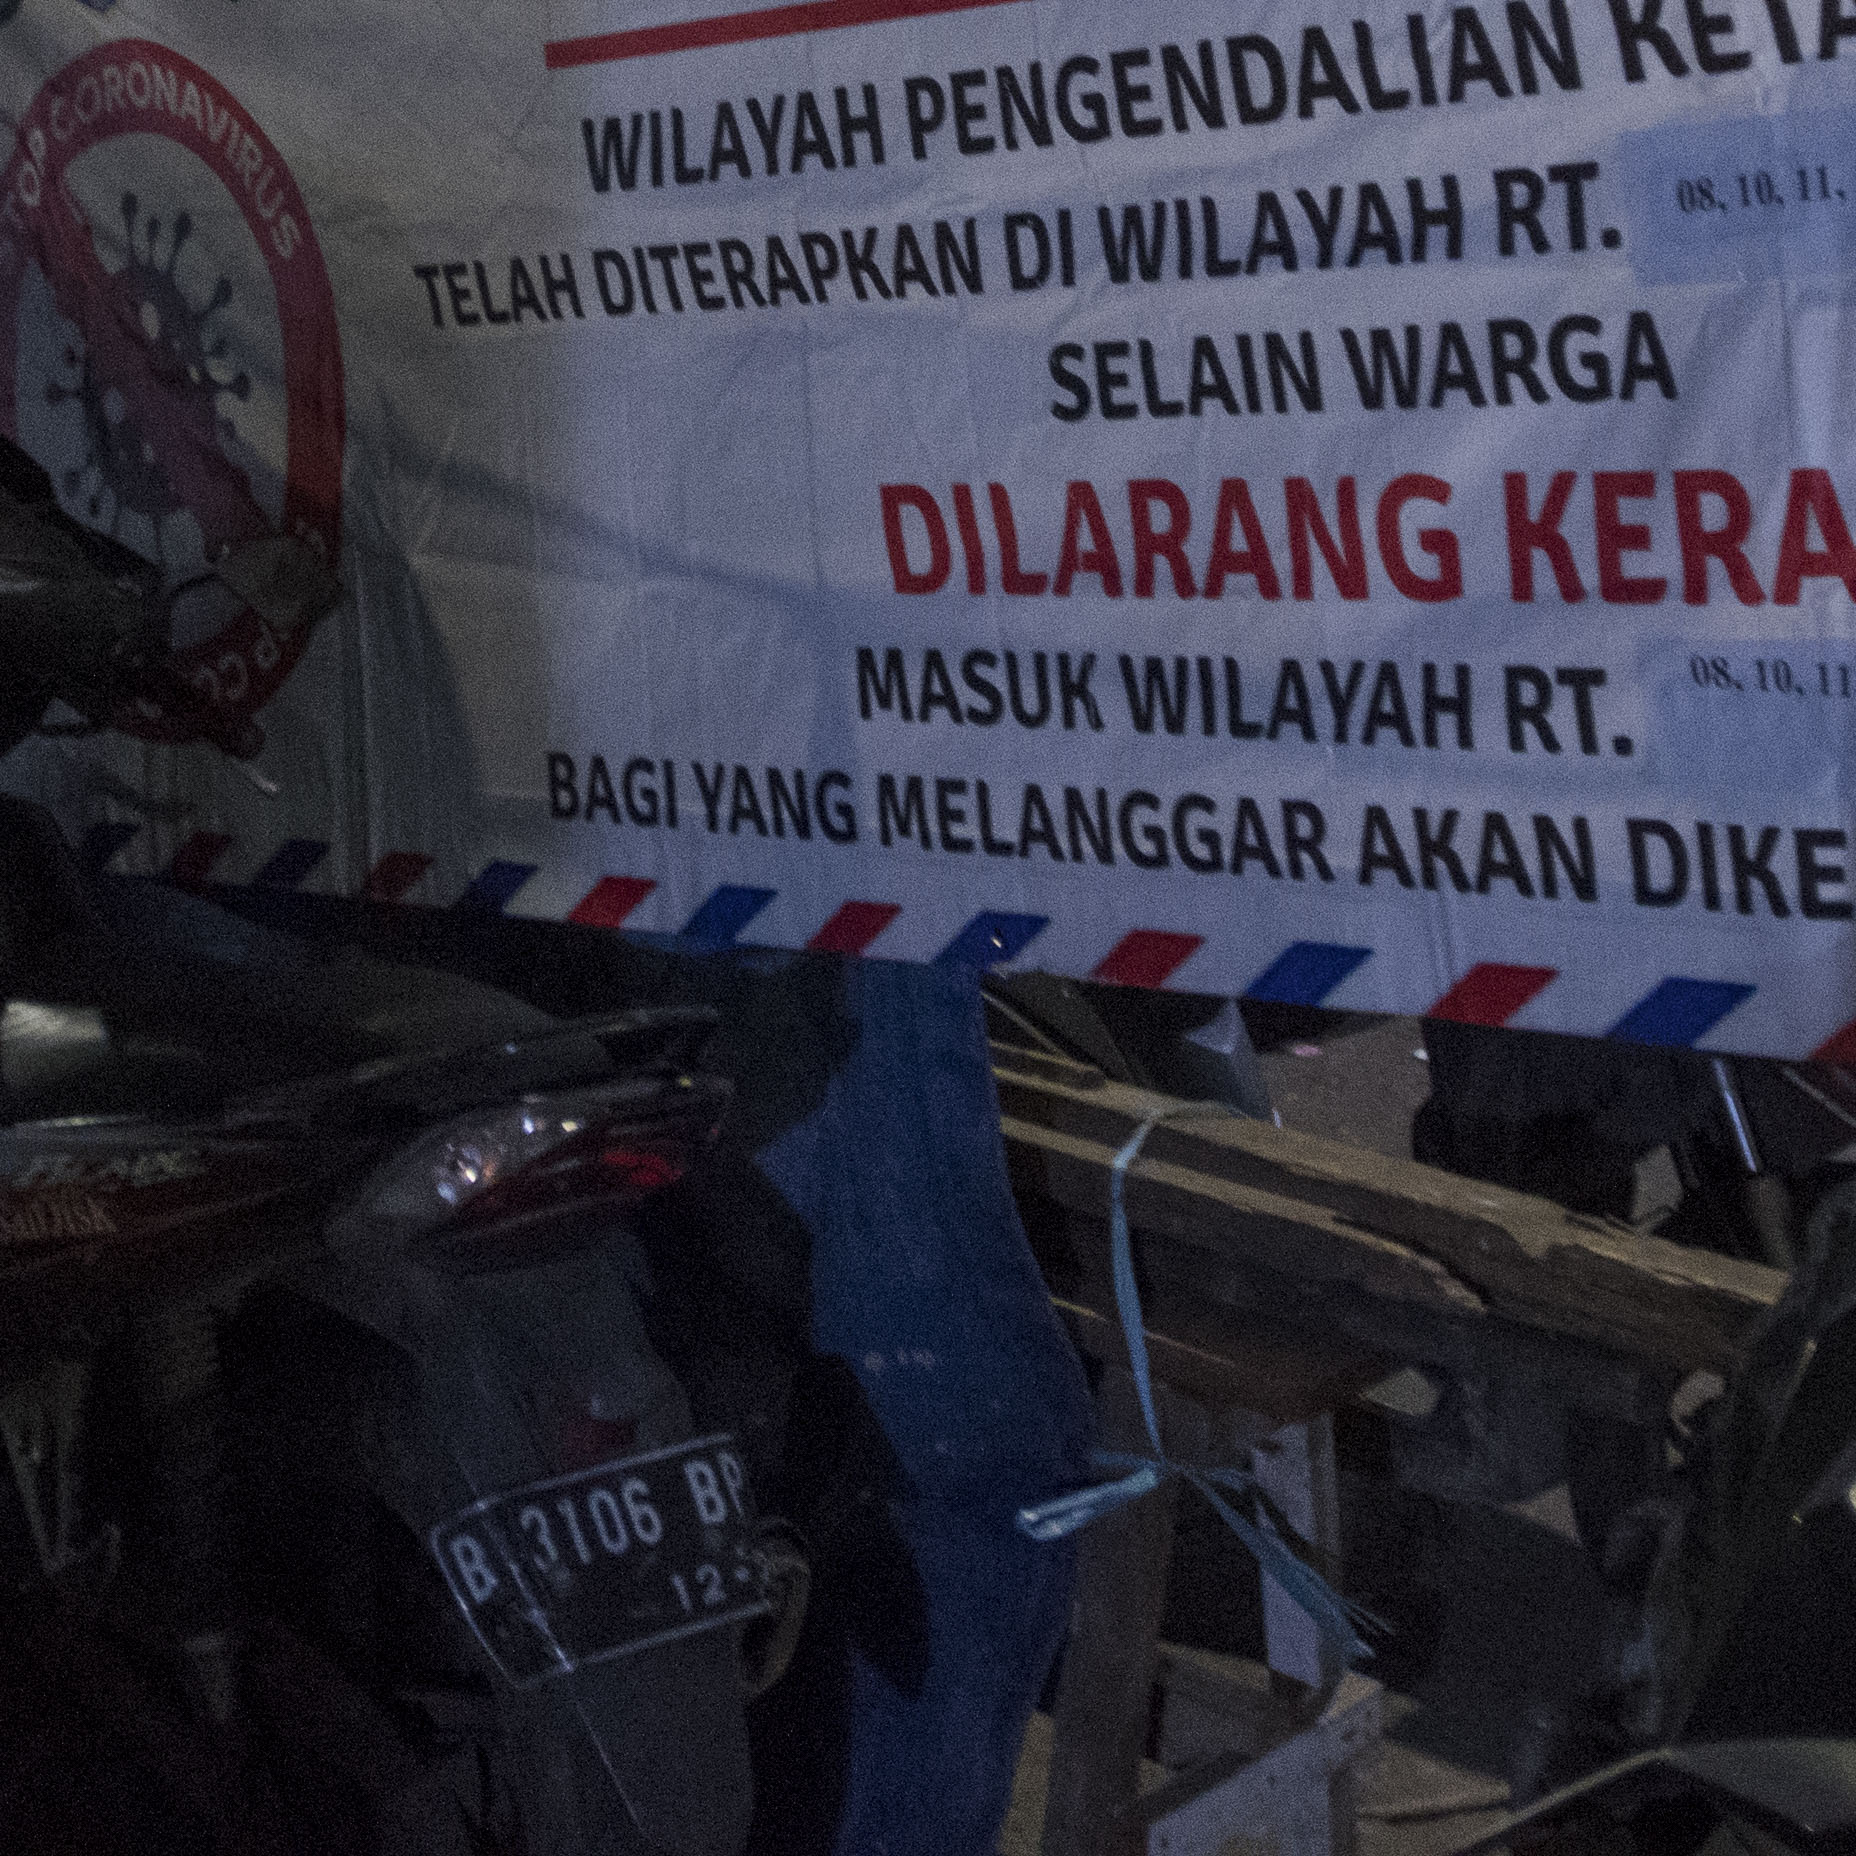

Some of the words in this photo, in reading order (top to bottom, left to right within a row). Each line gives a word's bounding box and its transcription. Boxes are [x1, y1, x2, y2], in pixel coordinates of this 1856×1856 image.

[50, 62, 302, 260] CORONAVIRUS
[581, 81, 885, 192] WILAYAH
[414, 252, 585, 328] TELAH
[595, 219, 984, 316] DITERAPKAN
[1003, 208, 1075, 291] DI
[1097, 169, 1463, 283] WILAYAH
[1494, 161, 1622, 257] RT.
[1049, 332, 1322, 422] SELAIN
[1340, 311, 1677, 410] WARGA
[879, 472, 1464, 602] DILARANG
[856, 647, 1103, 731] MASUK
[1118, 655, 1471, 749] WILAYAH
[1503, 665, 1635, 757] RT.
[546, 751, 677, 829] BAGI
[691, 762, 857, 844] YANG
[878, 772, 1335, 884] MELANGGAR
[1357, 805, 1599, 903] AKAN
[449, 1535, 499, 1604] B
[520, 1476, 663, 1572] 3106
